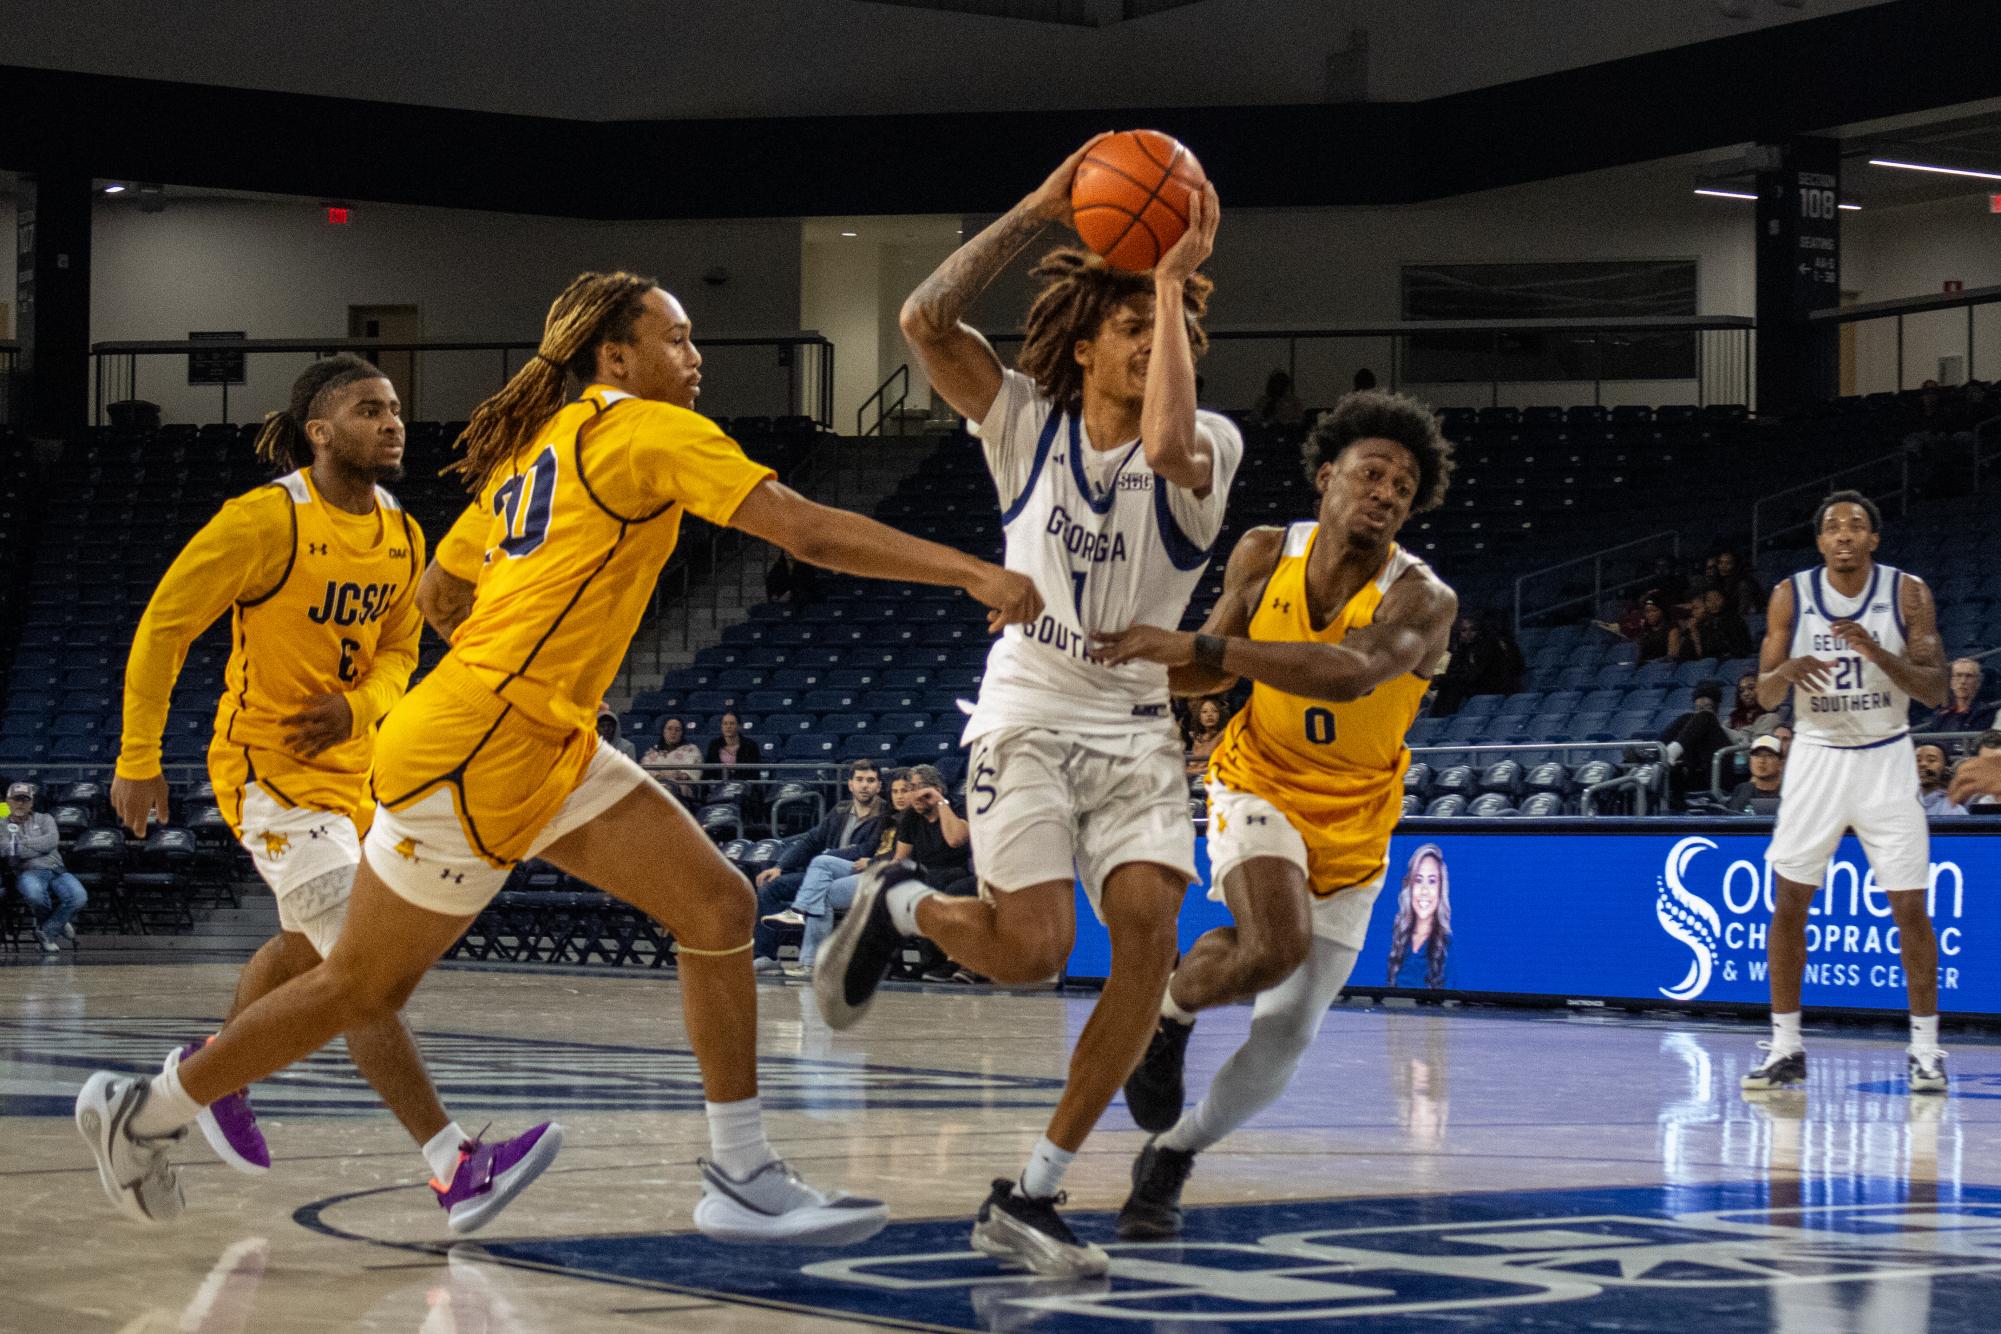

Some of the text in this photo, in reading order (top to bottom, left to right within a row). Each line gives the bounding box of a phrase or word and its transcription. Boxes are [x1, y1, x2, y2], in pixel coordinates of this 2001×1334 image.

[1799, 188, 1835, 219] 108
[308, 580, 397, 626] JCSU
[1836, 657, 1863, 690] 21
[1810, 691, 1892, 712] SOUTHERN
[1304, 706, 1336, 745] 0
[1722, 960, 1738, 982] &
